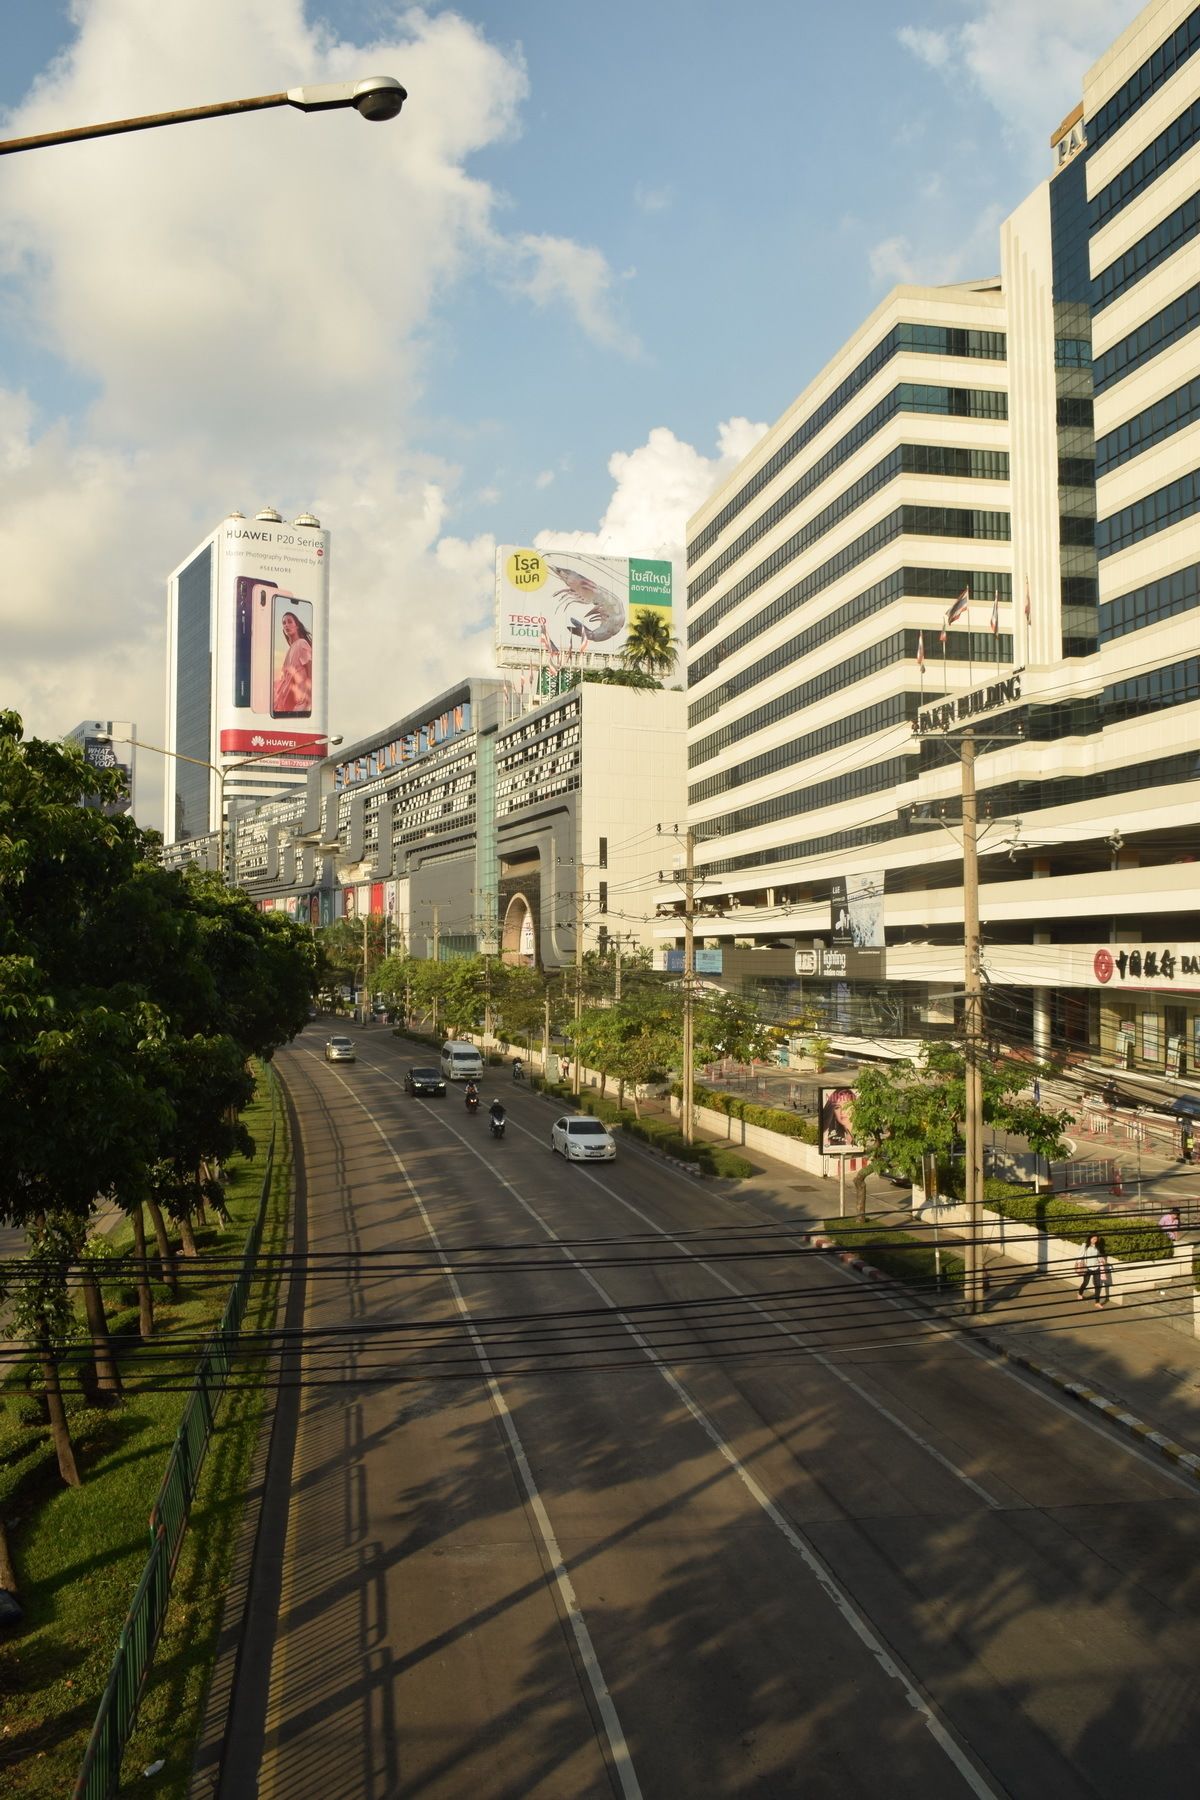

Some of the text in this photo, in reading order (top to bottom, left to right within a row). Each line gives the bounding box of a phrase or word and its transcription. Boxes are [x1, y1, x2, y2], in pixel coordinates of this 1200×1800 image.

[226, 530, 324, 549] HUAWEI P20 Series
[509, 614, 547, 624] TESCO
[511, 626, 542, 638] Lotu
[957, 675, 1021, 719] BUILDING
[266, 739, 297, 748] HUAWEI
[823, 950, 846, 969] lighting
[1181, 955, 1200, 975] BA
